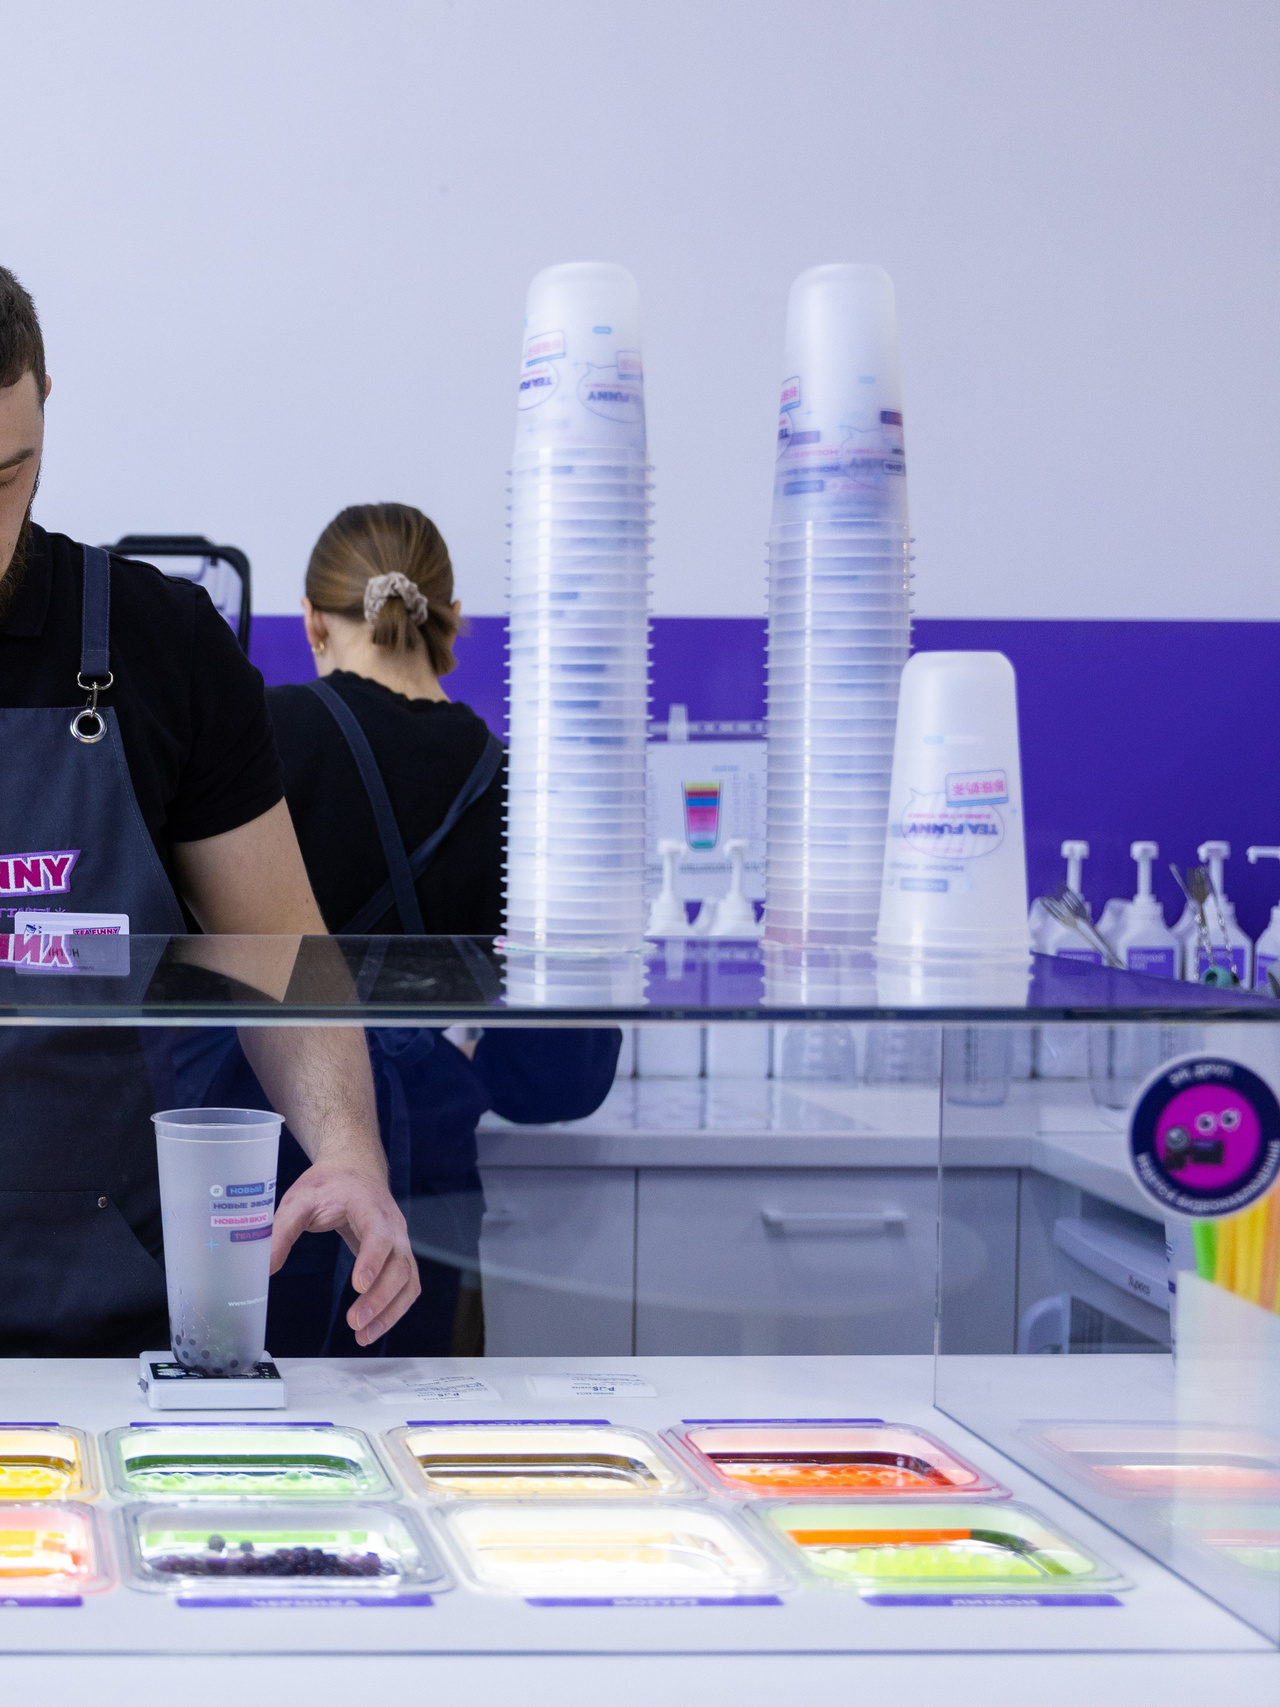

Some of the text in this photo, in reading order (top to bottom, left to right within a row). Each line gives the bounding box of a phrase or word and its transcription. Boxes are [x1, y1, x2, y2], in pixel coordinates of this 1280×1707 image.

[908, 823, 999, 837] TEA FUNNY
[230, 1185, 262, 1195] НОВЫЙ
[213, 1202, 248, 1210] НОВЫЕ
[214, 1214, 267, 1225] НОВЫЙ ВКУС
